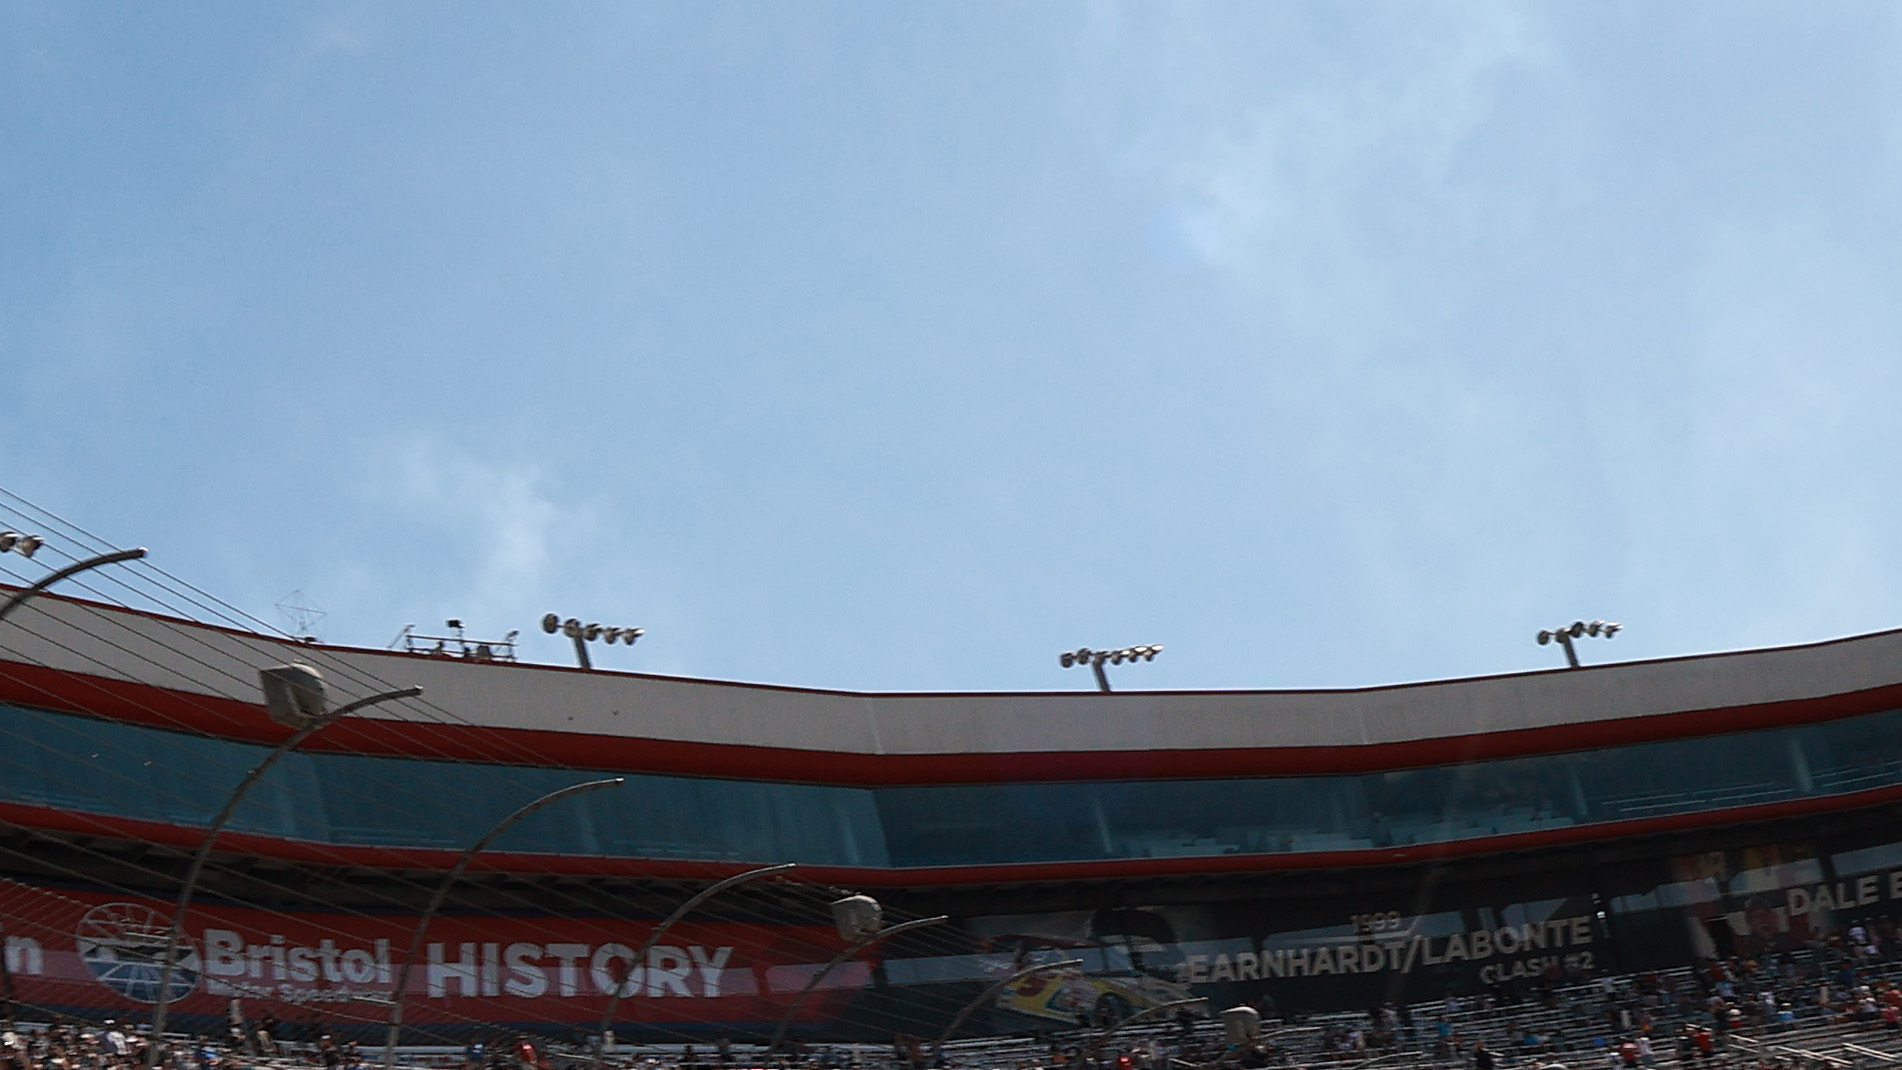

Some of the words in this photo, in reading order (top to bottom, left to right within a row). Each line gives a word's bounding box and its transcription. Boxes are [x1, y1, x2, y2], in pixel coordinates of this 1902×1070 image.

[1350, 910, 1399, 934] 1999
[1785, 874, 1881, 916] DALE
[204, 929, 393, 984] Bristol
[427, 942, 735, 999] HISTORY
[1189, 915, 1592, 984] EARNHARDT/LABONTE
